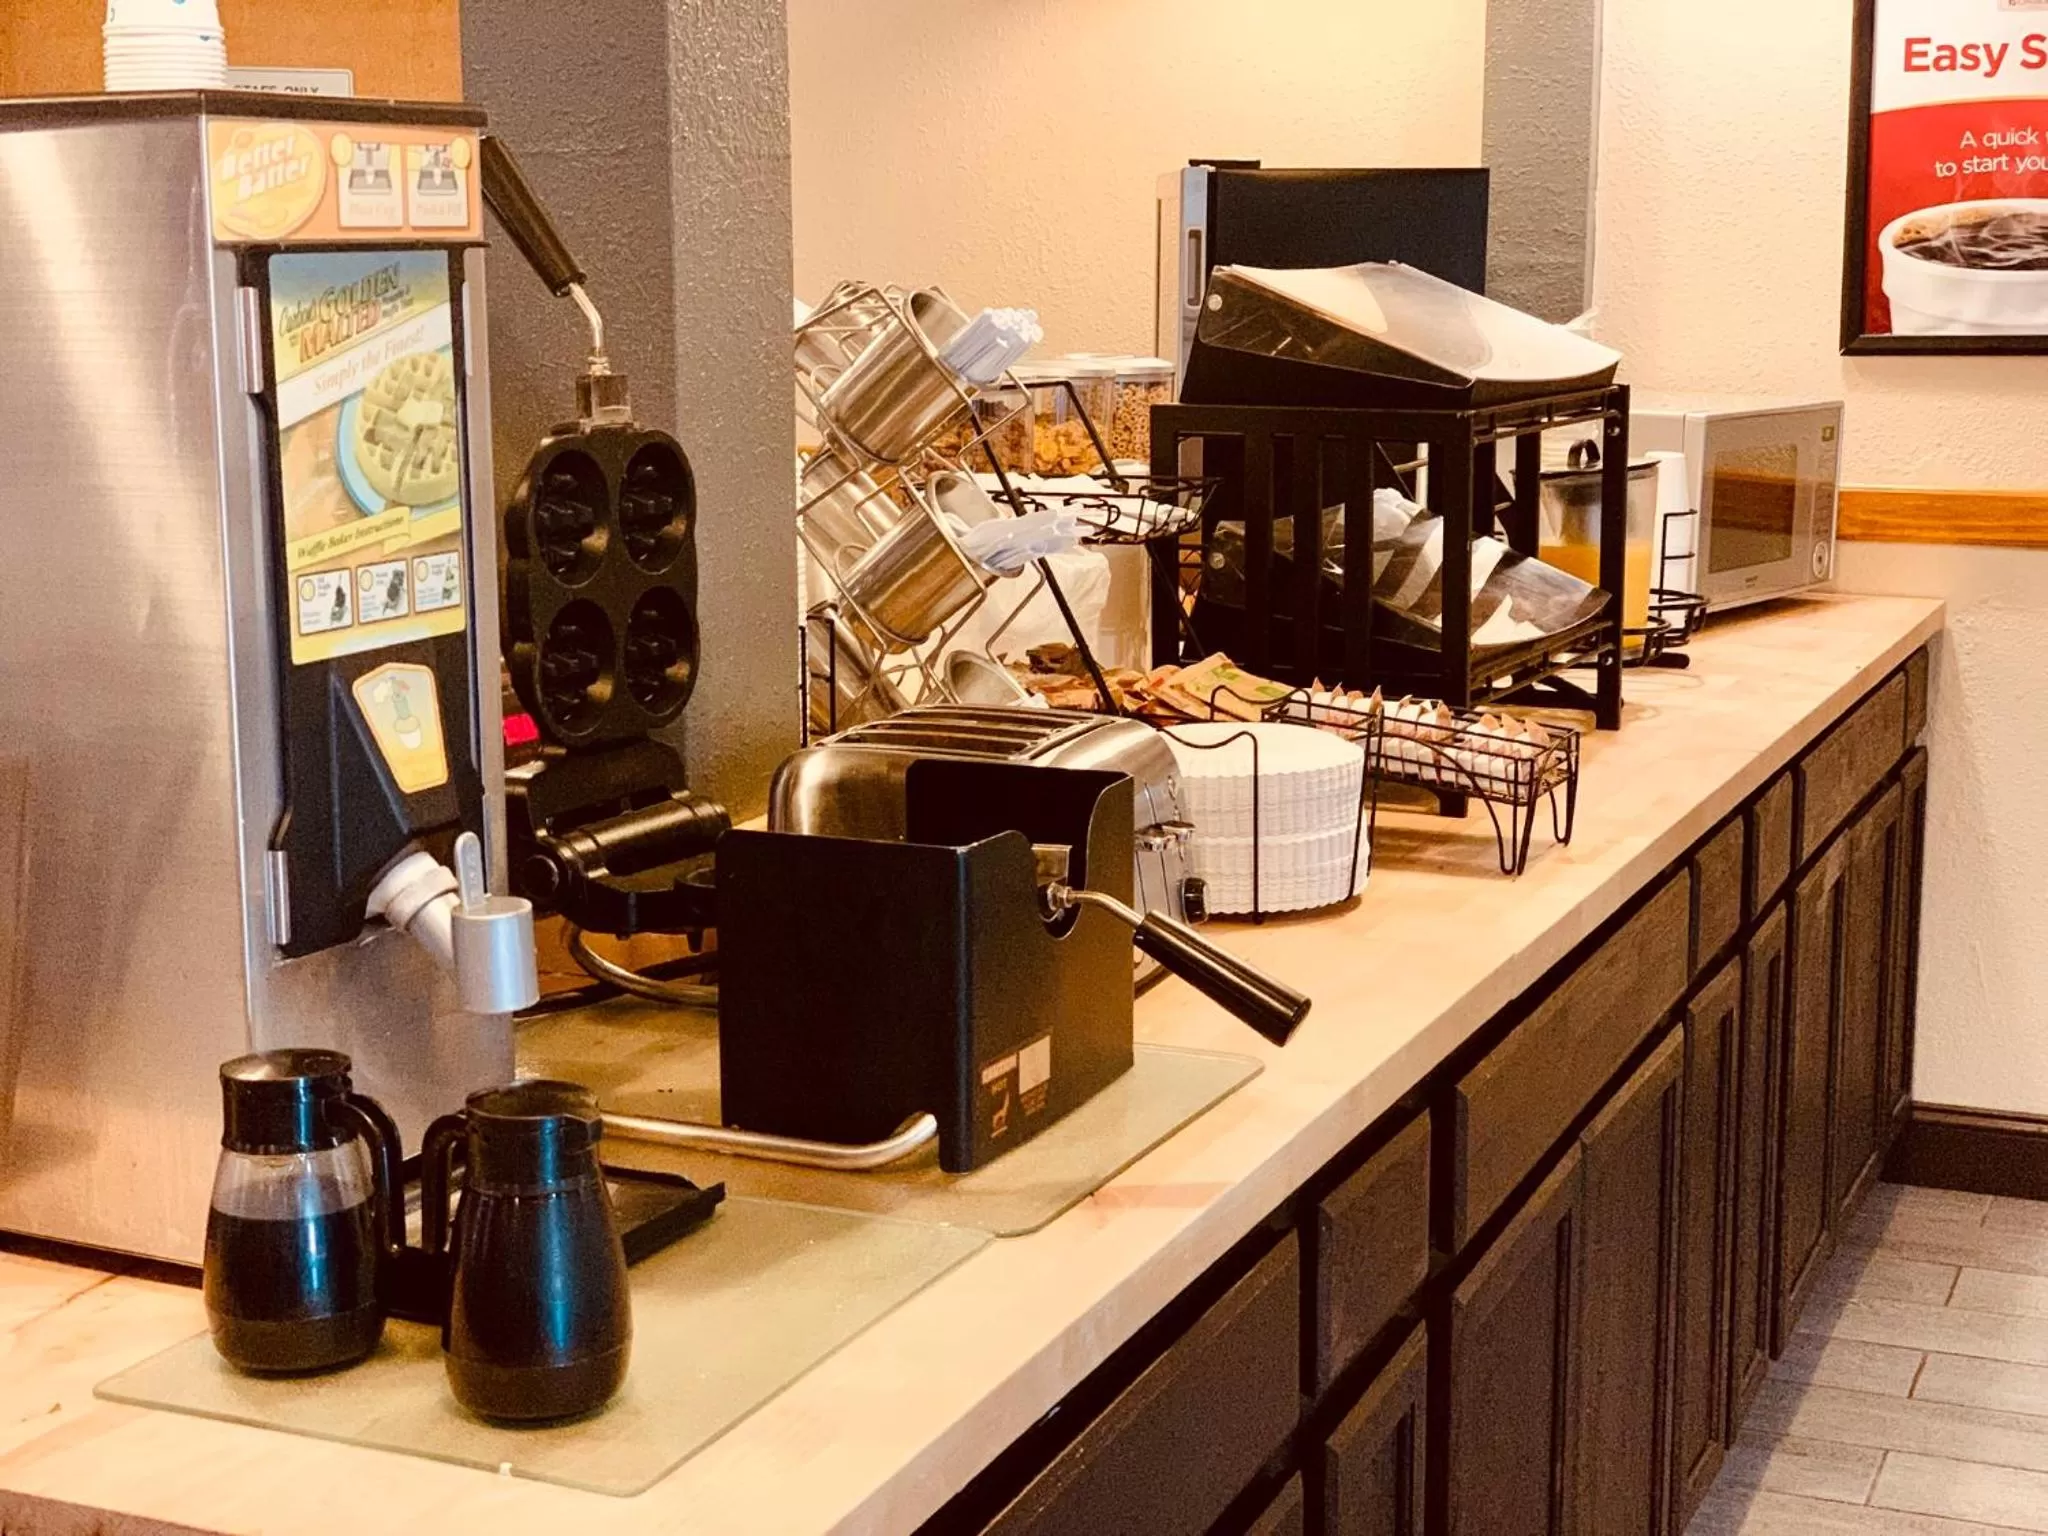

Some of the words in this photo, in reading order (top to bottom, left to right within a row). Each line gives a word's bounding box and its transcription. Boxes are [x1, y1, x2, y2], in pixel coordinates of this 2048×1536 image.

[1904, 37, 2009, 78] Easy
[1959, 130, 1977, 149] A
[1983, 126, 2039, 149] quick
[1934, 160, 1957, 177] to
[1962, 154, 2009, 173] start
